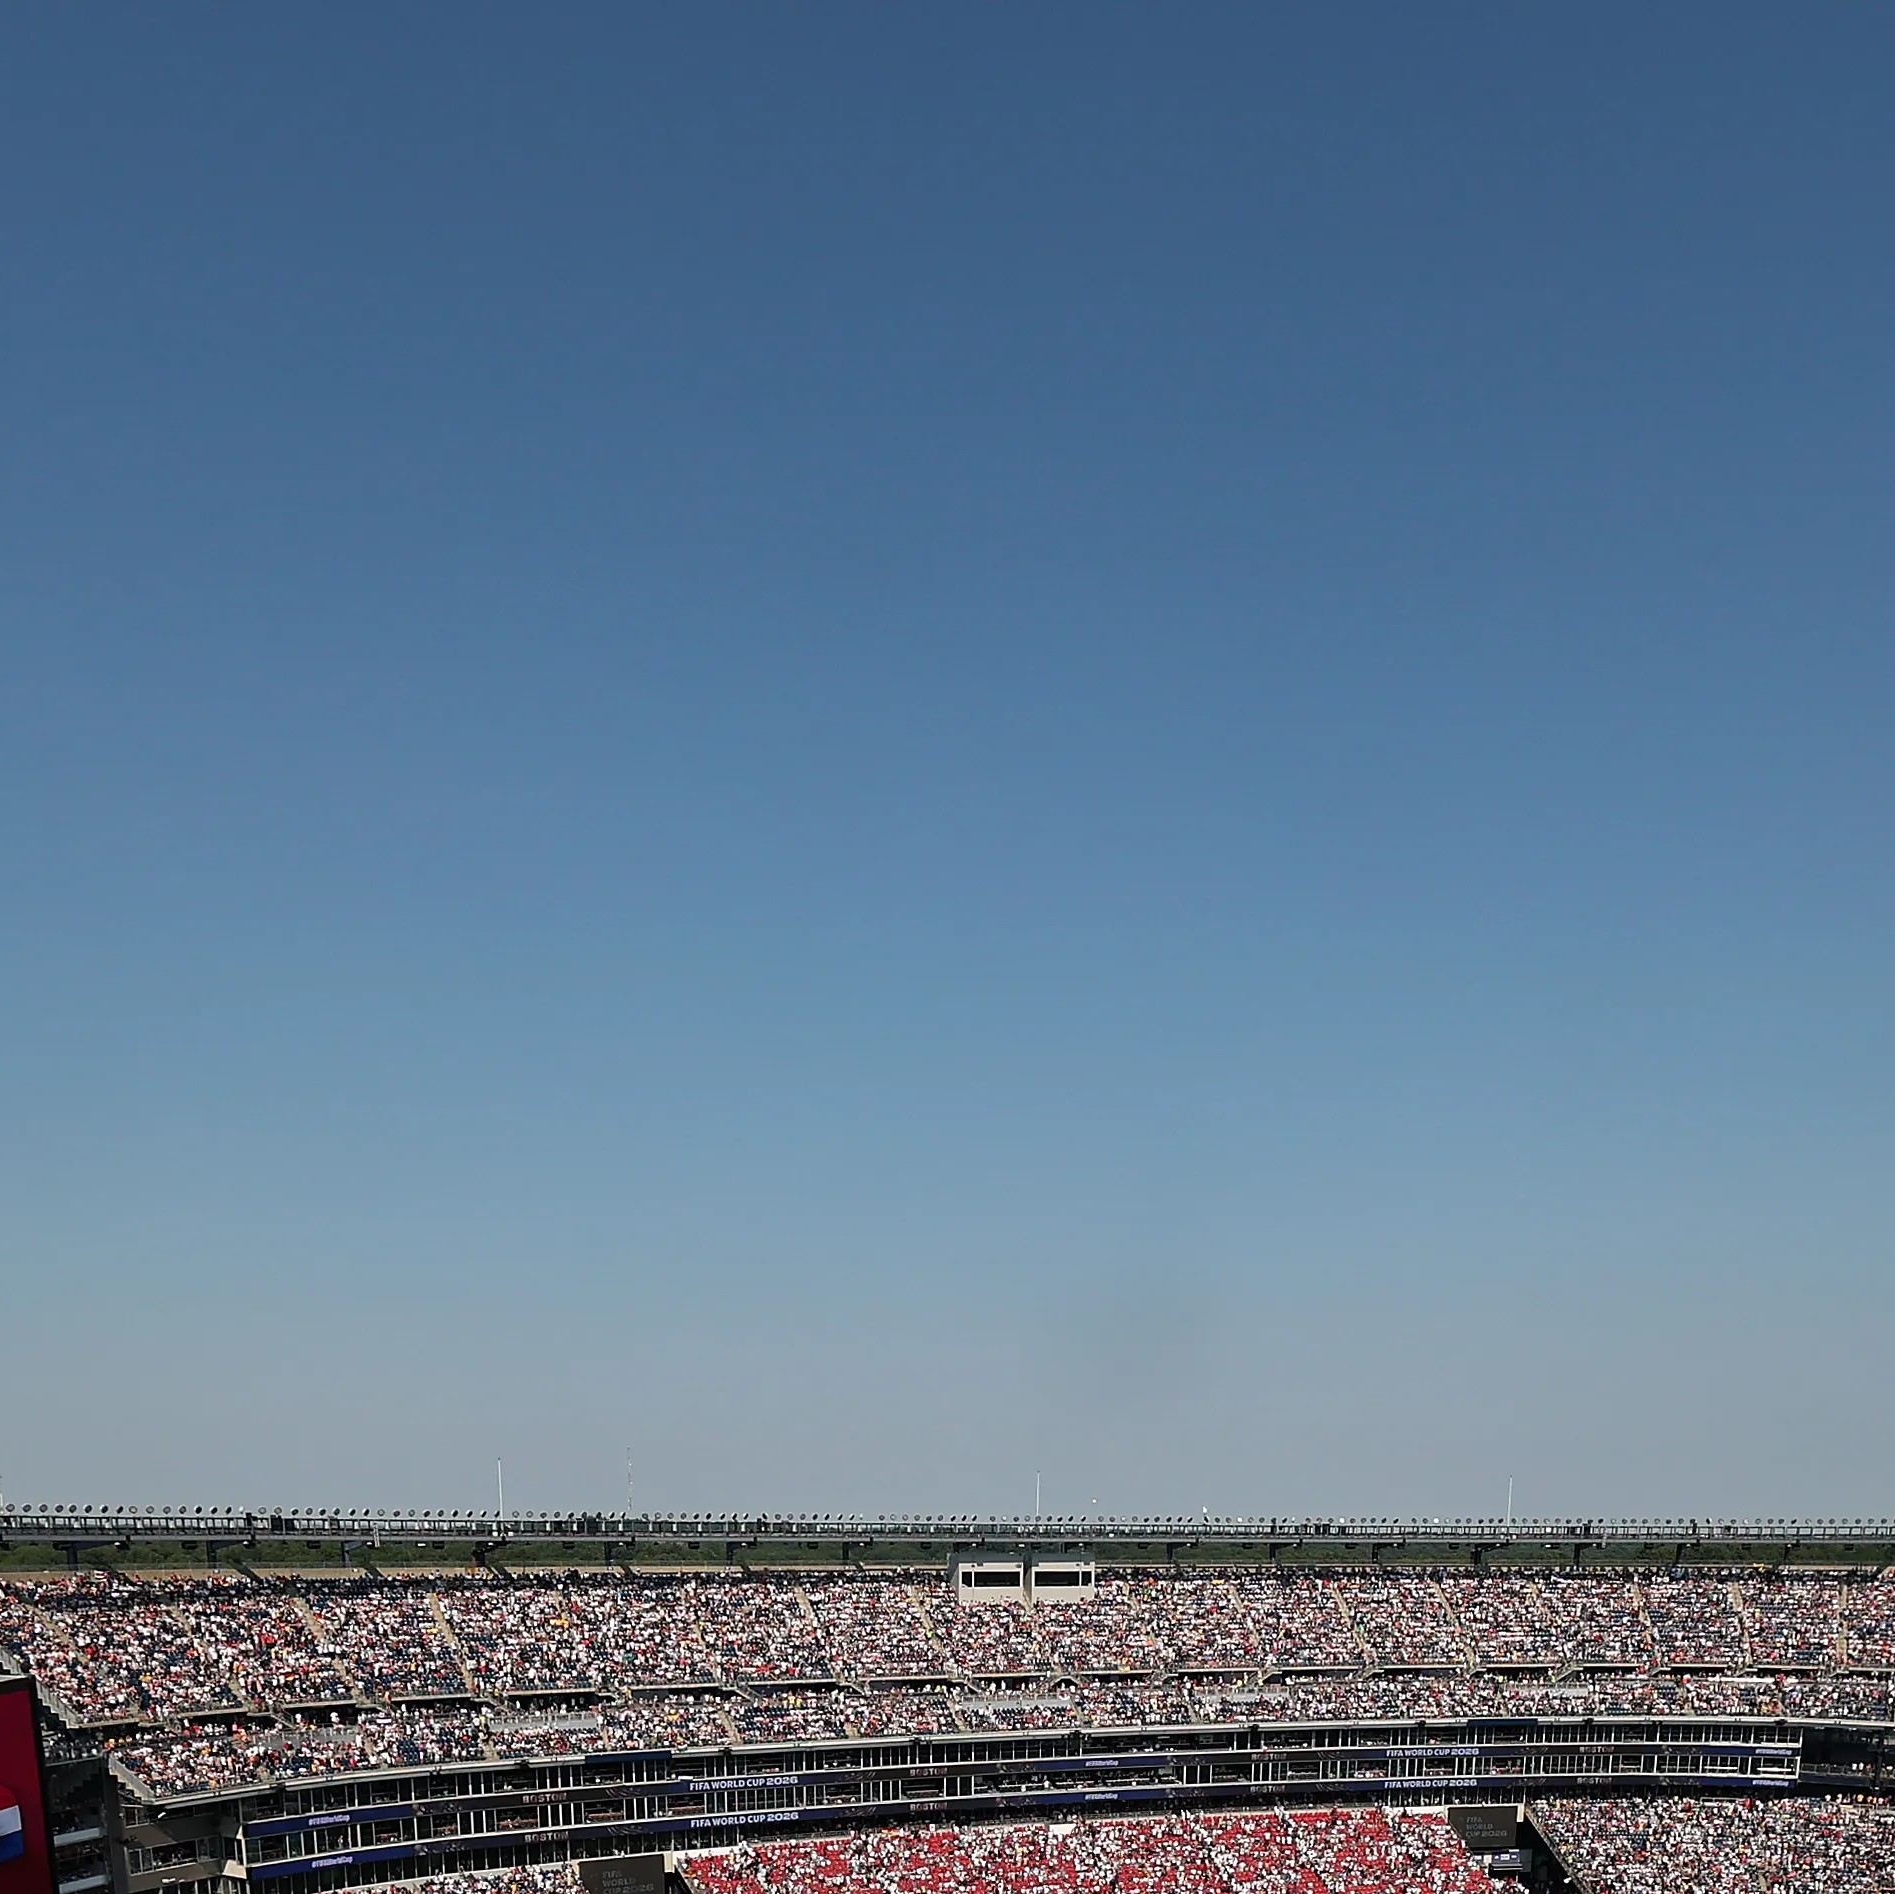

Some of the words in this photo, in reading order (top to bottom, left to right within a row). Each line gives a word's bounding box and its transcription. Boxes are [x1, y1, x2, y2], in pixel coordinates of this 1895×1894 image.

[1386, 1749, 1406, 1758] FIFA
[1407, 1749, 1434, 1757] WORLD
[1435, 1748, 1451, 1756] CUP
[1451, 1748, 1479, 1756] 2026
[910, 1767, 947, 1776] BOSTON
[690, 1781, 710, 1791] FIFA
[711, 1779, 745, 1789] WORLD
[746, 1778, 766, 1787] CUP
[767, 1776, 798, 1785] 2026
[1384, 1781, 1402, 1789] FIFA
[1403, 1780, 1431, 1788] WORLD
[1449, 1779, 1477, 1787] 2026
[522, 1793, 567, 1804] BOSTON
[691, 1818, 711, 1828] FIFA
[712, 1815, 746, 1826] WORLD
[747, 1814, 766, 1824] CUP
[767, 1812, 799, 1821] 2026
[524, 1831, 569, 1843] BOSTON
[603, 1870, 622, 1878] FIFA
[603, 1879, 636, 1887] WORLD
[603, 1887, 621, 1894] CUP
[622, 1884, 654, 1893] 2026
